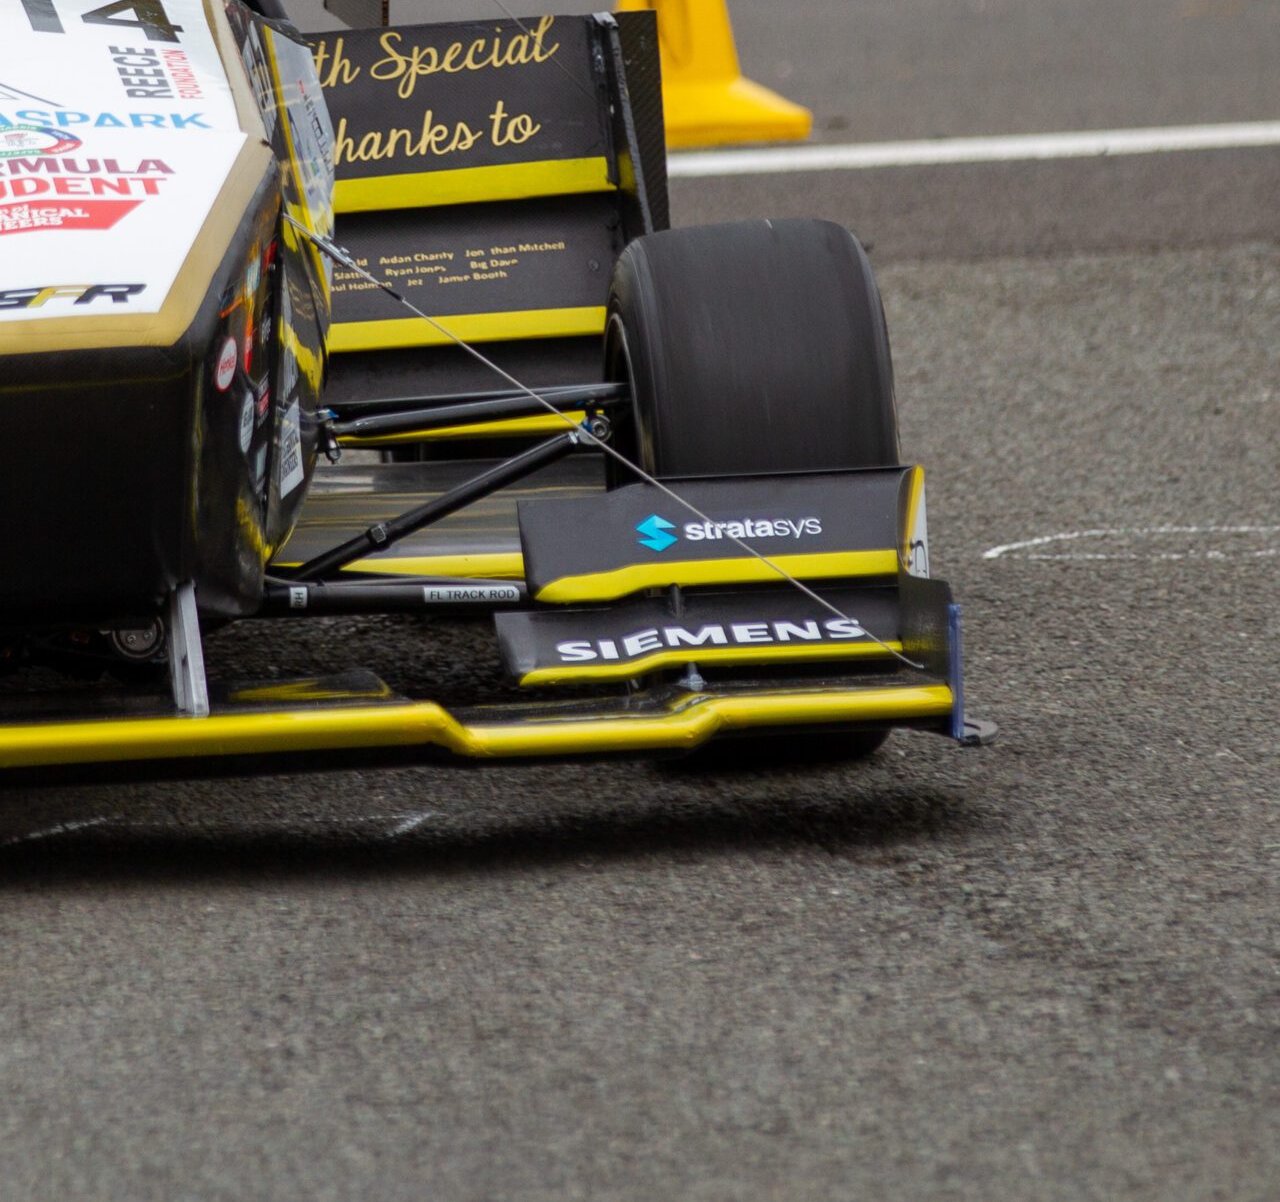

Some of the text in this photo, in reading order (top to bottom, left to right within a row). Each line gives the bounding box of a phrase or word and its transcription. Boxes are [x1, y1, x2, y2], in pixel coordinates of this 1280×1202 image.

[108, 45, 175, 99] REECE
[160, 48, 205, 99] FOUNDATION
[371, 15, 560, 98] Special
[334, 110, 482, 166] hanks
[489, 100, 541, 145] to
[518, 241, 565, 253] Mitchell
[385, 267, 413, 277] Ryan
[473, 270, 507, 281] Booth
[683, 516, 823, 542] stratasys
[448, 590, 486, 599] TRACK
[490, 589, 515, 599] ROD
[558, 619, 867, 661] SIEMENS
